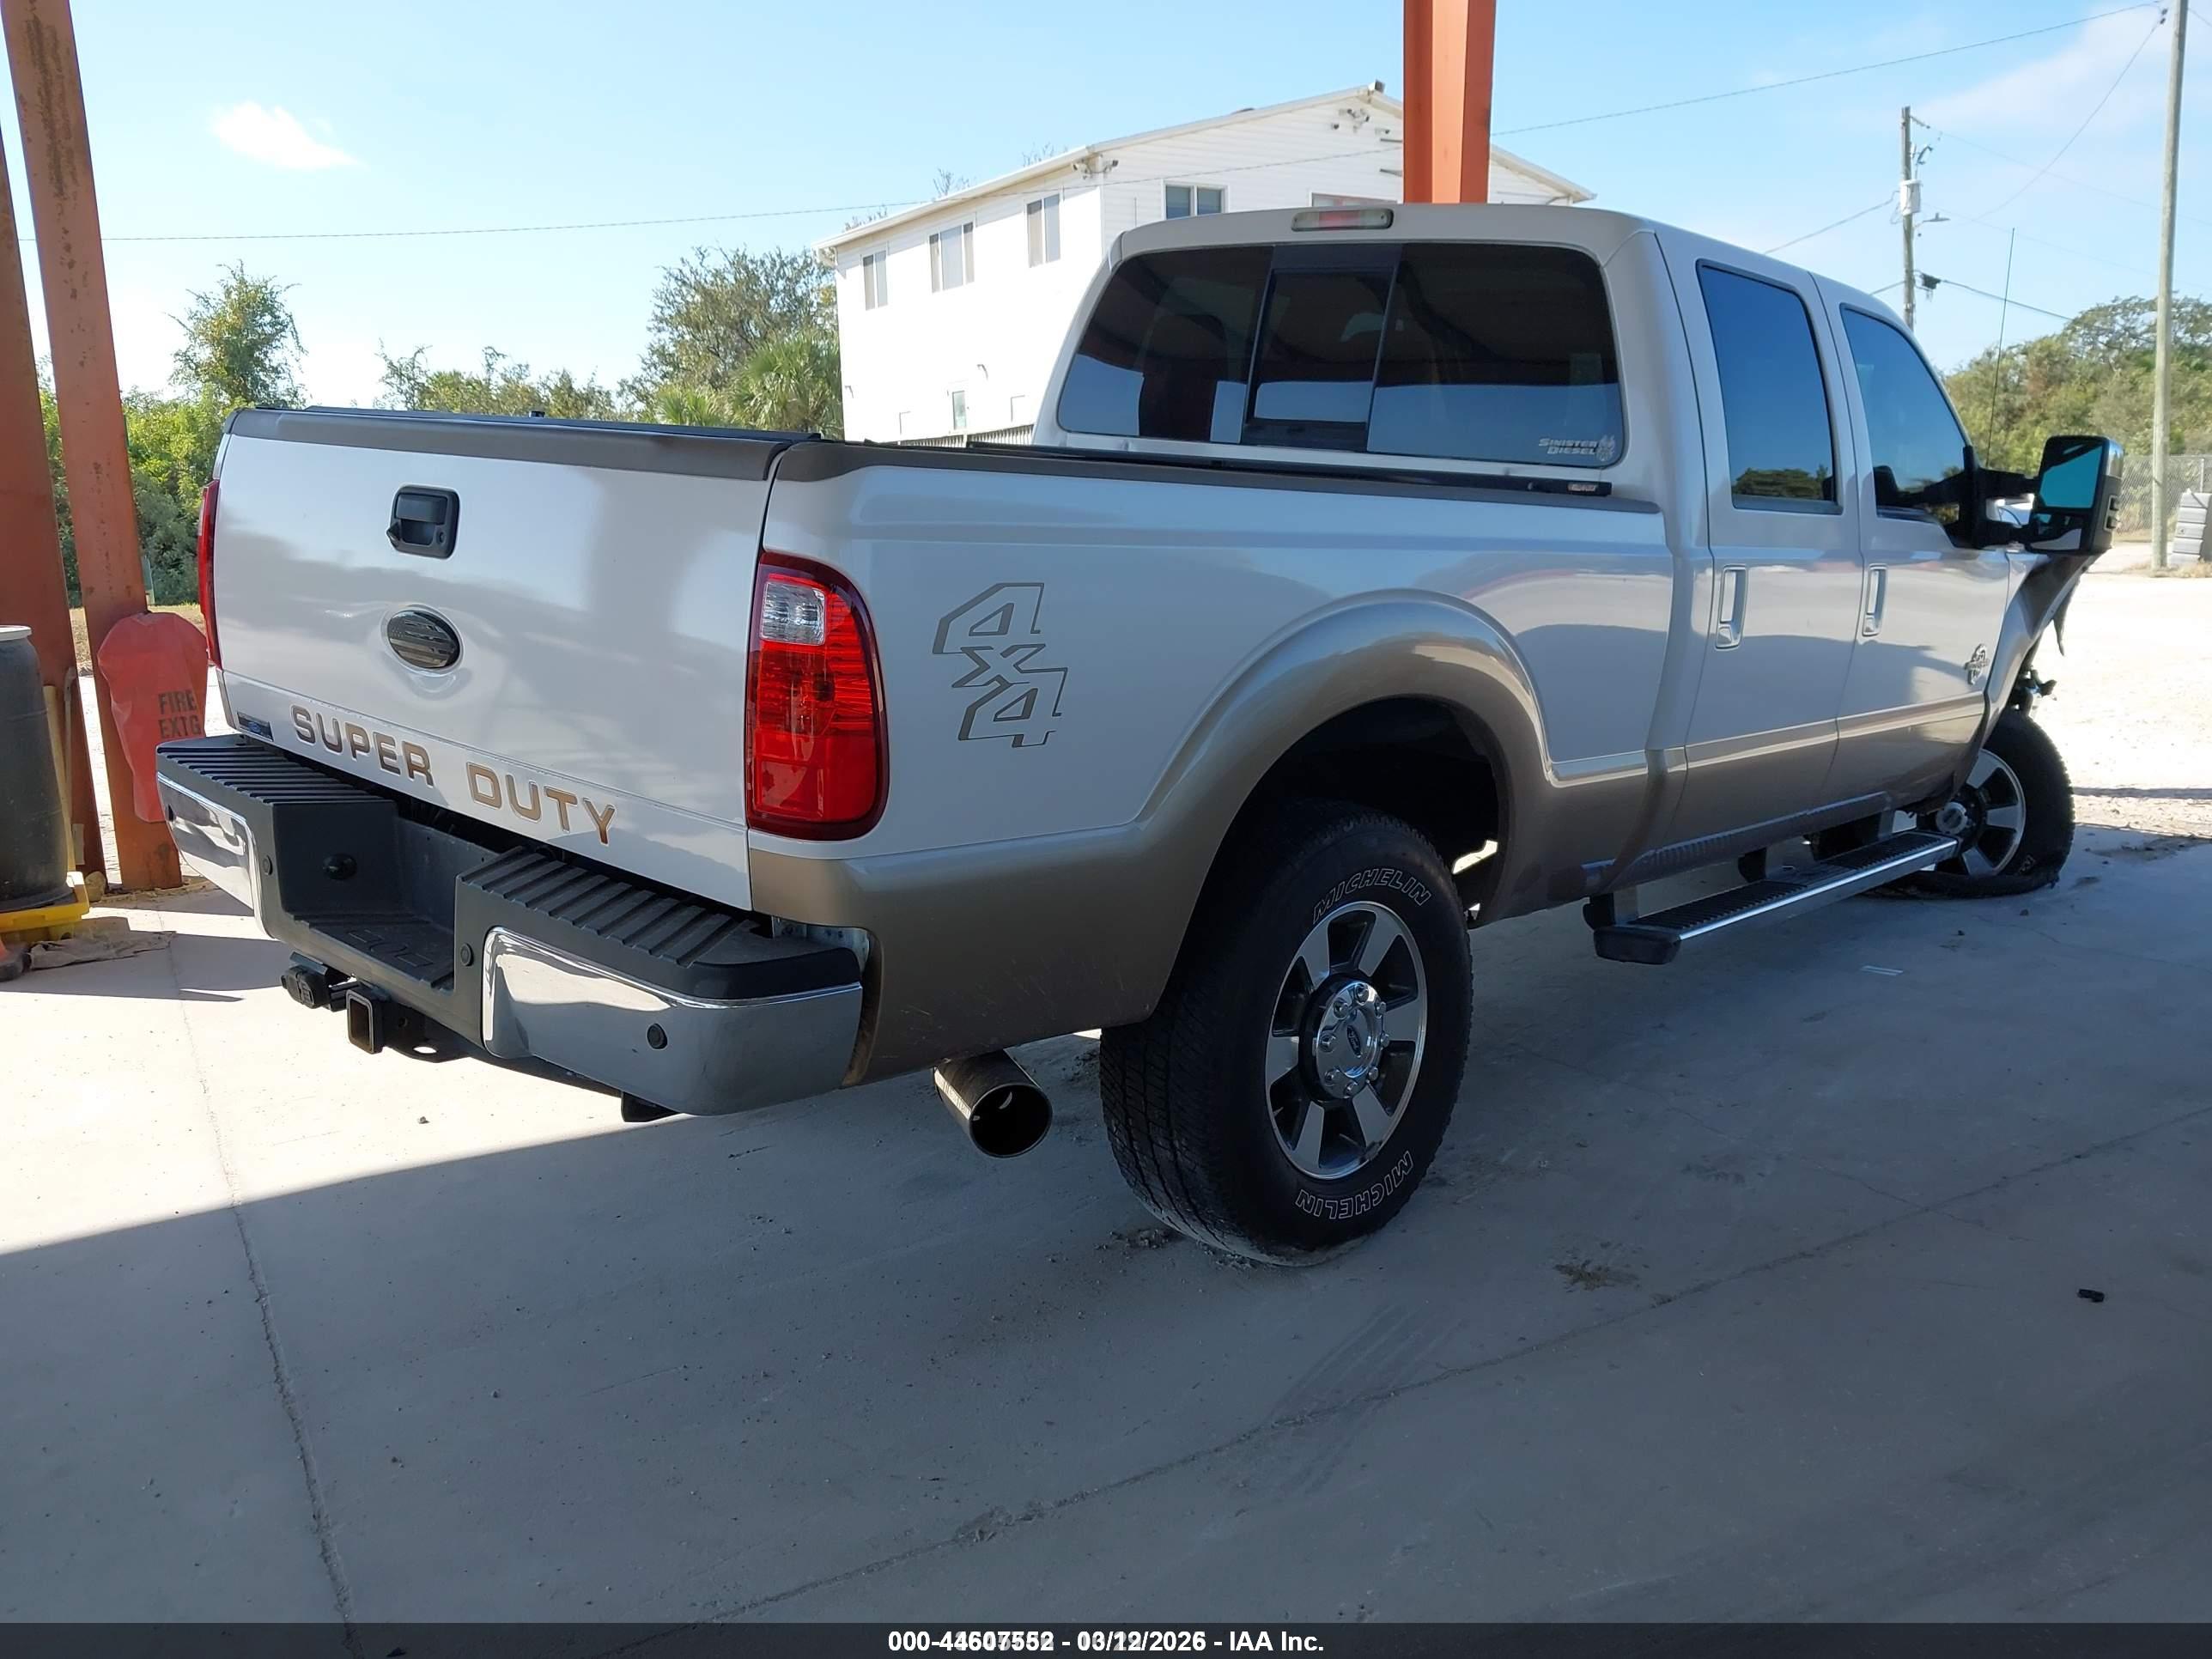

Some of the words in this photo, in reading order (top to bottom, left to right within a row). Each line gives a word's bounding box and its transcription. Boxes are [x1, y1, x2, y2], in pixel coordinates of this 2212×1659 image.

[158, 690, 198, 715] FIRE
[158, 715, 202, 739] EXTG
[289, 703, 434, 788] SUPER
[465, 761, 617, 846] DUTY
[1313, 867, 1432, 925] MICHELIN
[1295, 1151, 1414, 1220] MICHELIN
